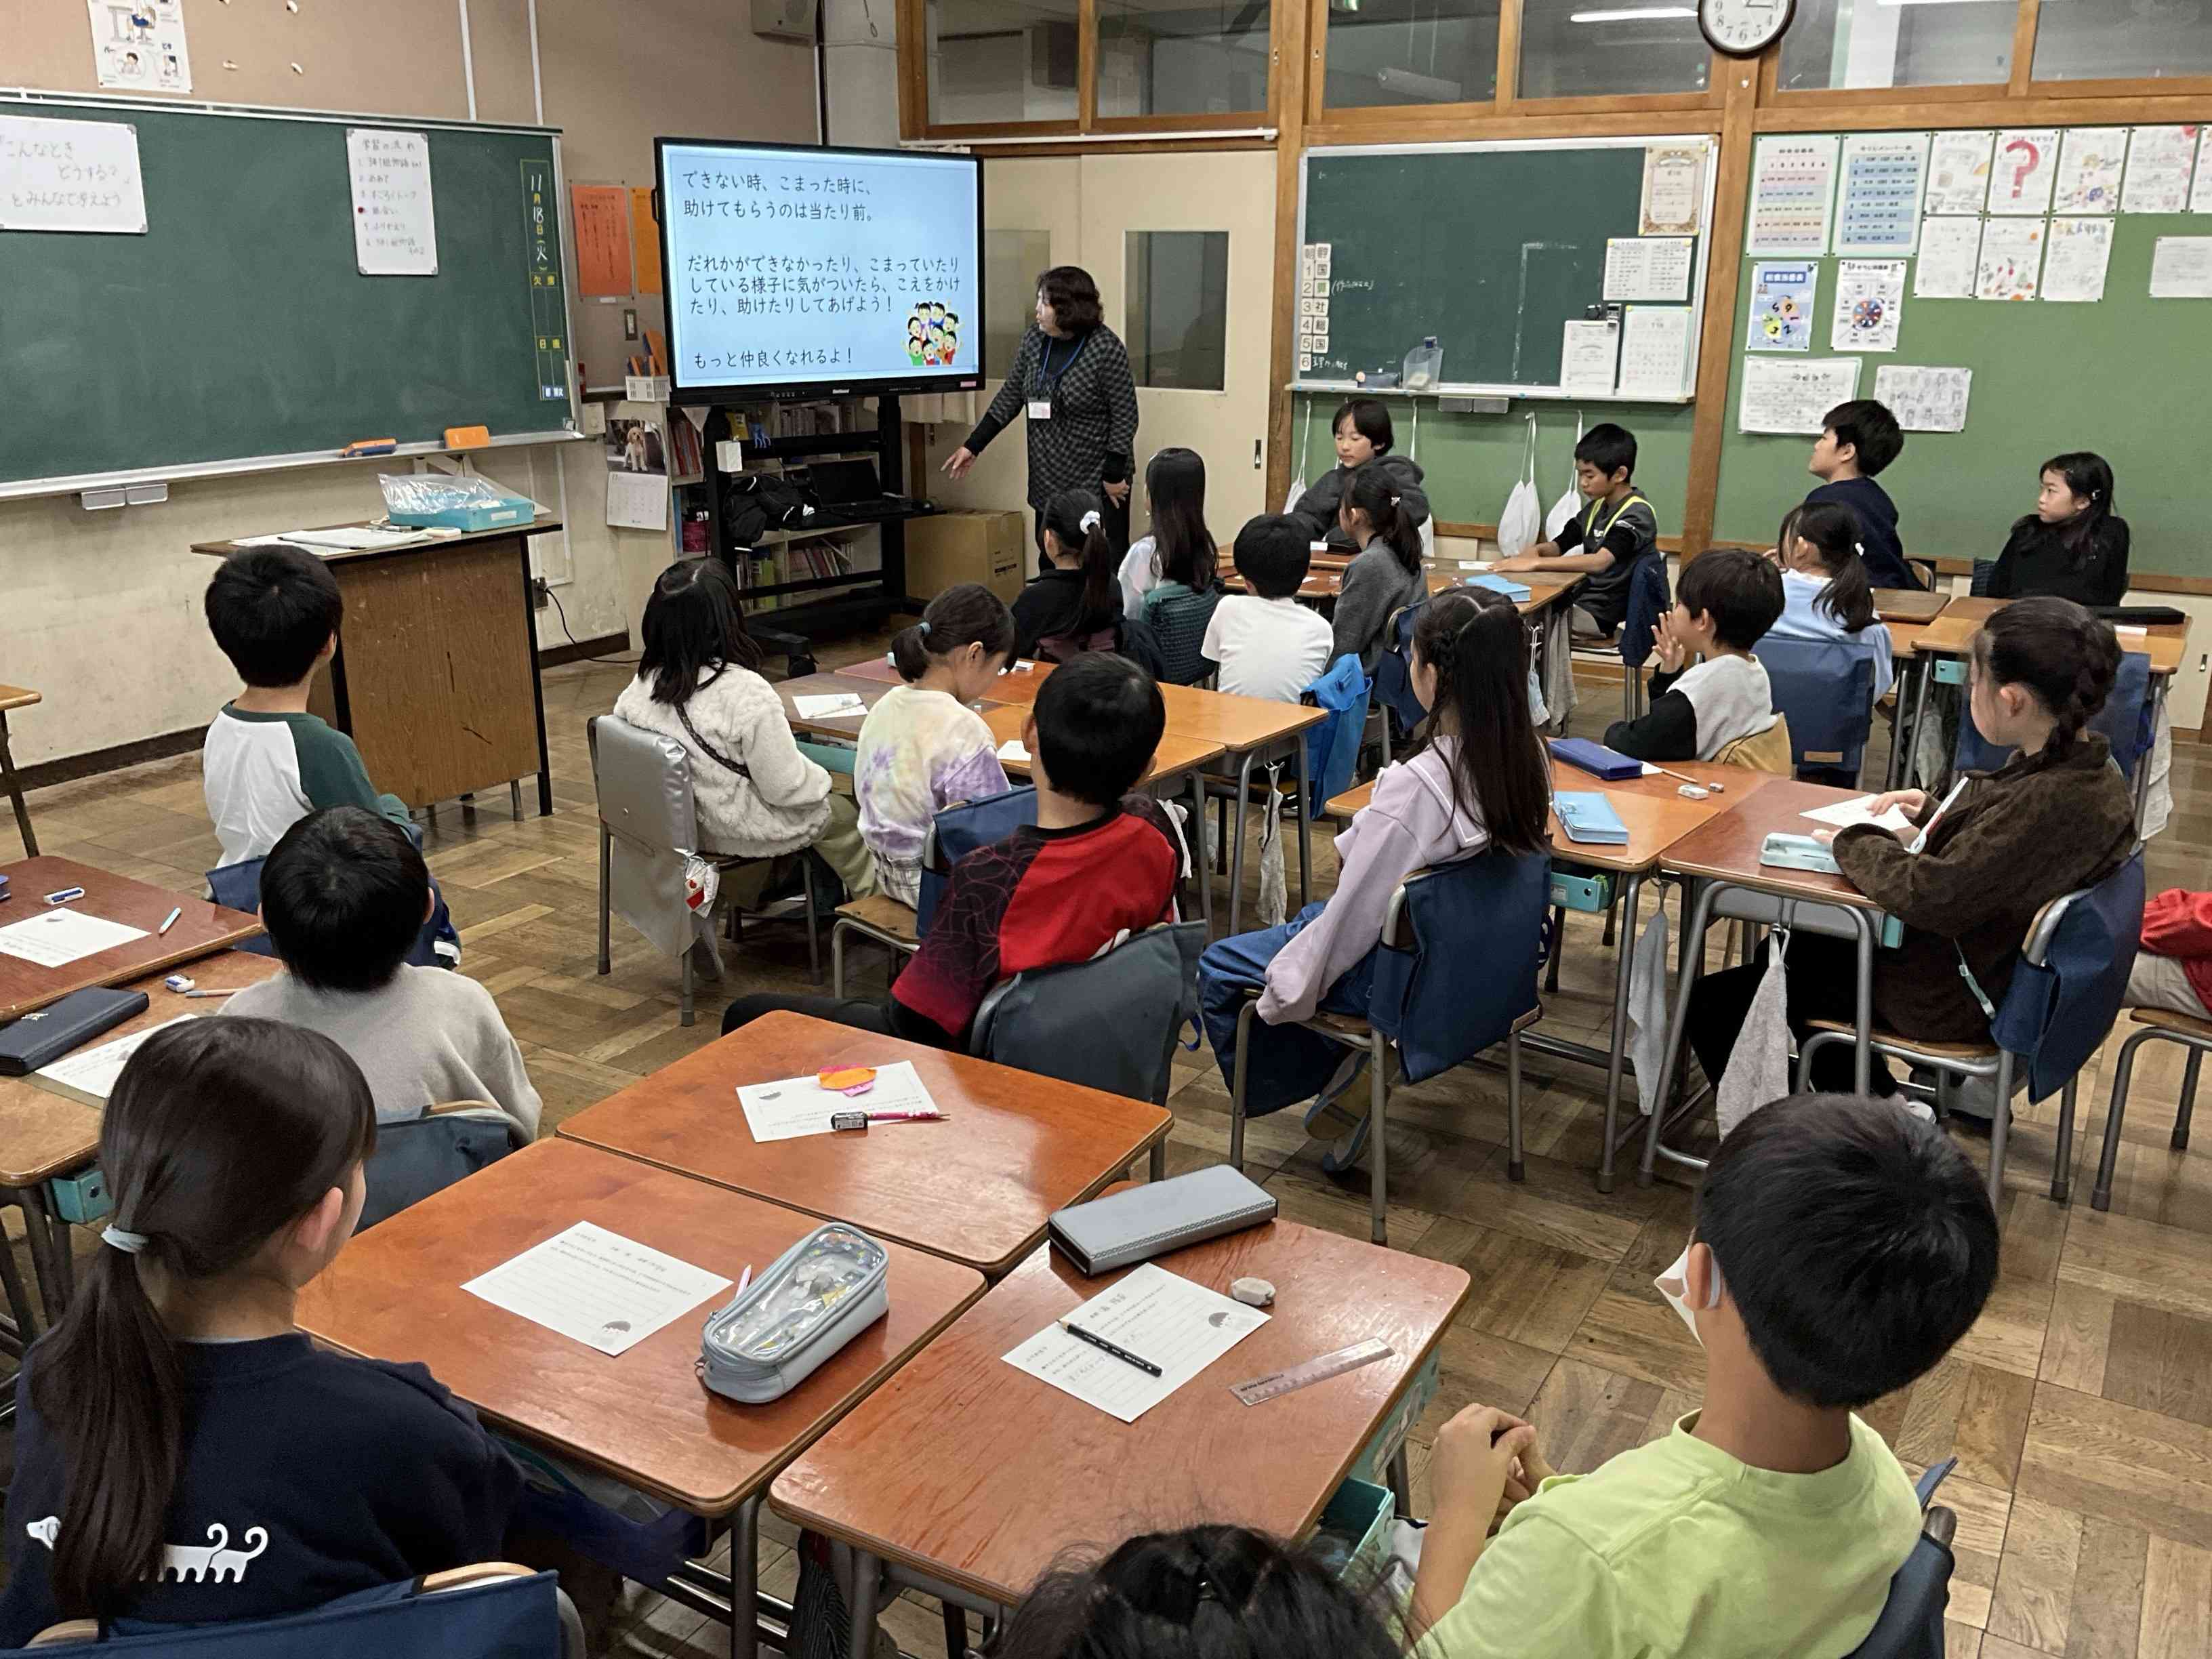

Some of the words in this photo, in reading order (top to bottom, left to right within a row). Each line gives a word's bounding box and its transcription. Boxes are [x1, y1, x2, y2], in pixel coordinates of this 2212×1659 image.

[682, 171, 872, 195] できない時、こまった時に、
[683, 199, 873, 222] 助けてもらうのは当たり前。
[688, 255, 959, 273] だれかができなかったり、こまっていたり
[690, 275, 960, 294] している様子に気がついたら、こえをかけ
[1303, 282, 1311, 293] 2
[1303, 301, 1311, 312] 3
[1315, 301, 1326, 313] 社
[1303, 320, 1310, 330] 4
[1303, 338, 1310, 348] 5
[1301, 357, 1310, 367] 6
